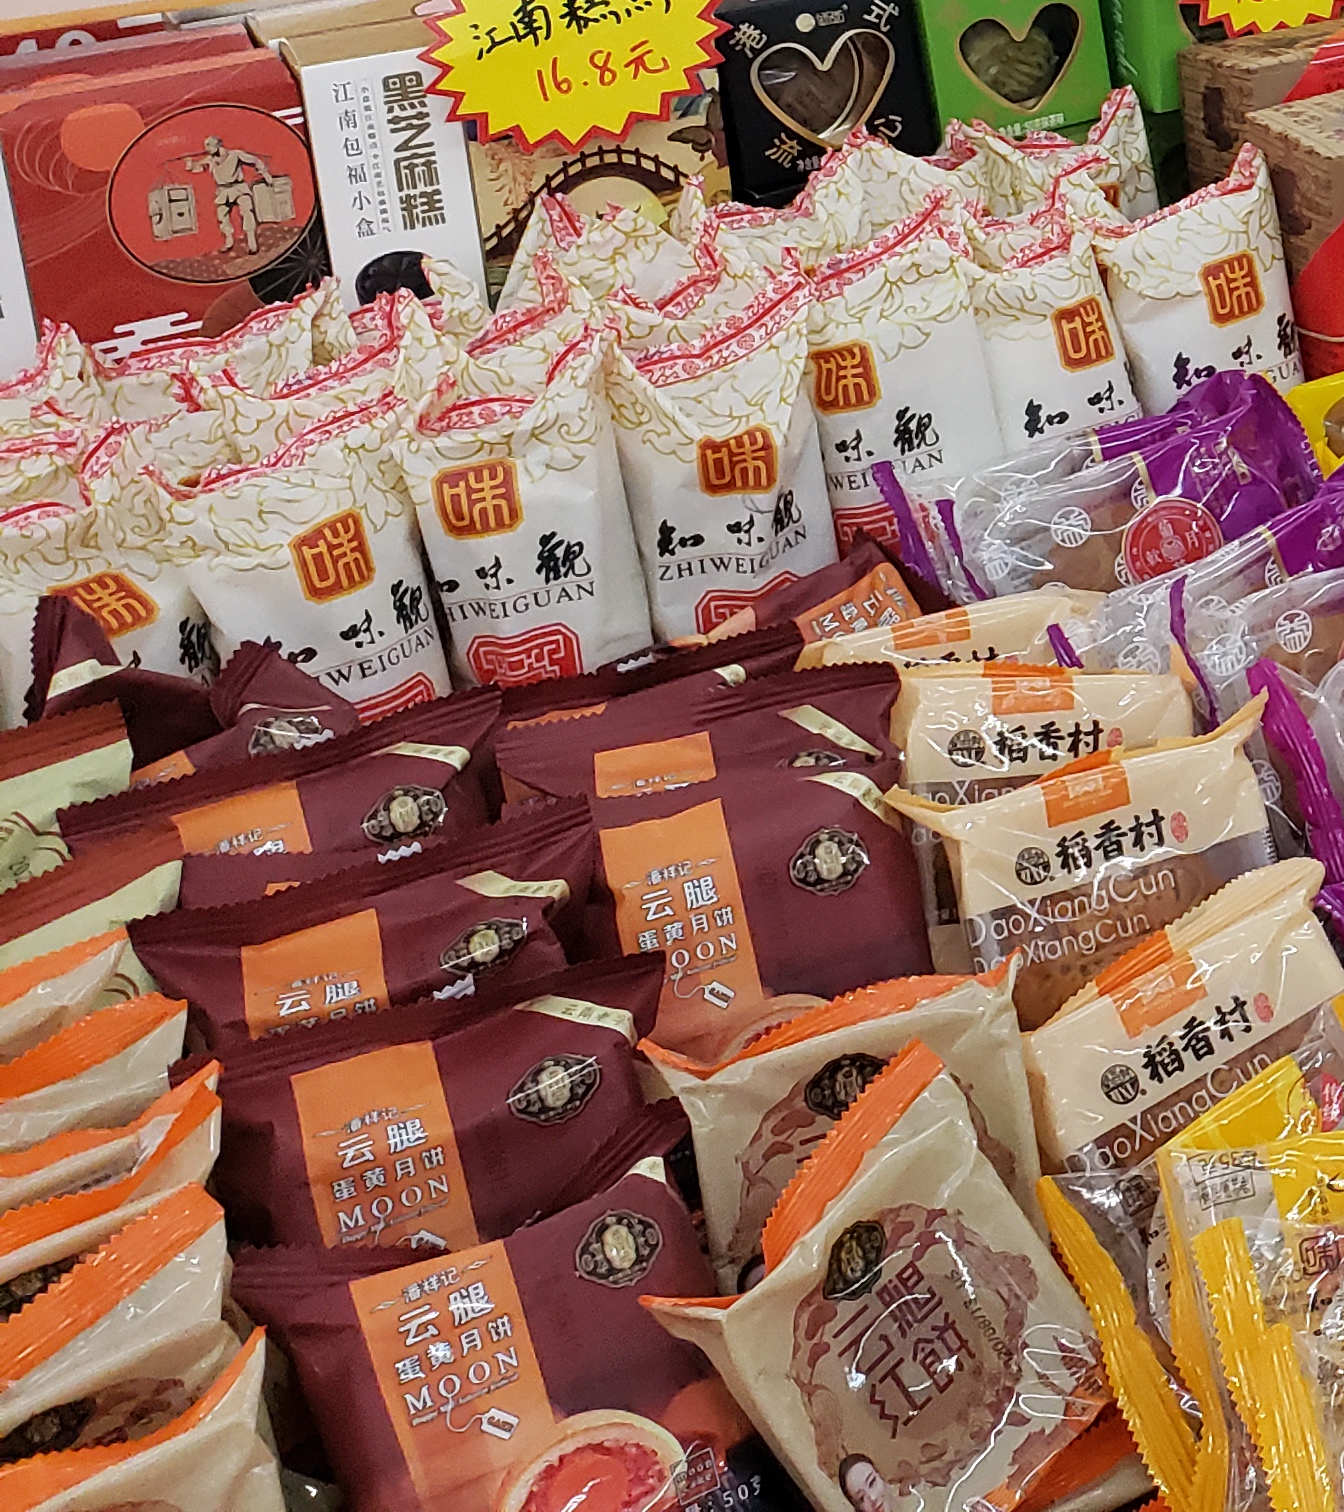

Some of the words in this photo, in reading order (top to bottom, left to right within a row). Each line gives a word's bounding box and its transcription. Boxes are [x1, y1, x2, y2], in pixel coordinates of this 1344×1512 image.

[535, 40, 670, 102] 16.8元
[381, 71, 447, 231] 黑芝麻糕
[764, 132, 804, 169] 流
[657, 524, 809, 582] ZHIWEIGUAN
[447, 579, 597, 624] HIWEIGUAN
[322, 629, 437, 687] WEIGUAN
[1054, 808, 1167, 876] 稻香村
[640, 874, 719, 922] 云腿
[967, 866, 1176, 947] DaoXiangCun
[637, 905, 735, 953] 蛋黄月饼
[668, 933, 738, 969] OON
[276, 979, 362, 1018] 云腿
[1143, 993, 1253, 1085] 稻香村
[335, 1117, 430, 1170] 云腿
[331, 1145, 447, 1202] 蛋黄月饼
[336, 1174, 451, 1234] MOON
[395, 1283, 496, 1348] 云腿
[393, 1313, 515, 1385] 蛋黄月饼
[402, 1344, 520, 1418] MOON
